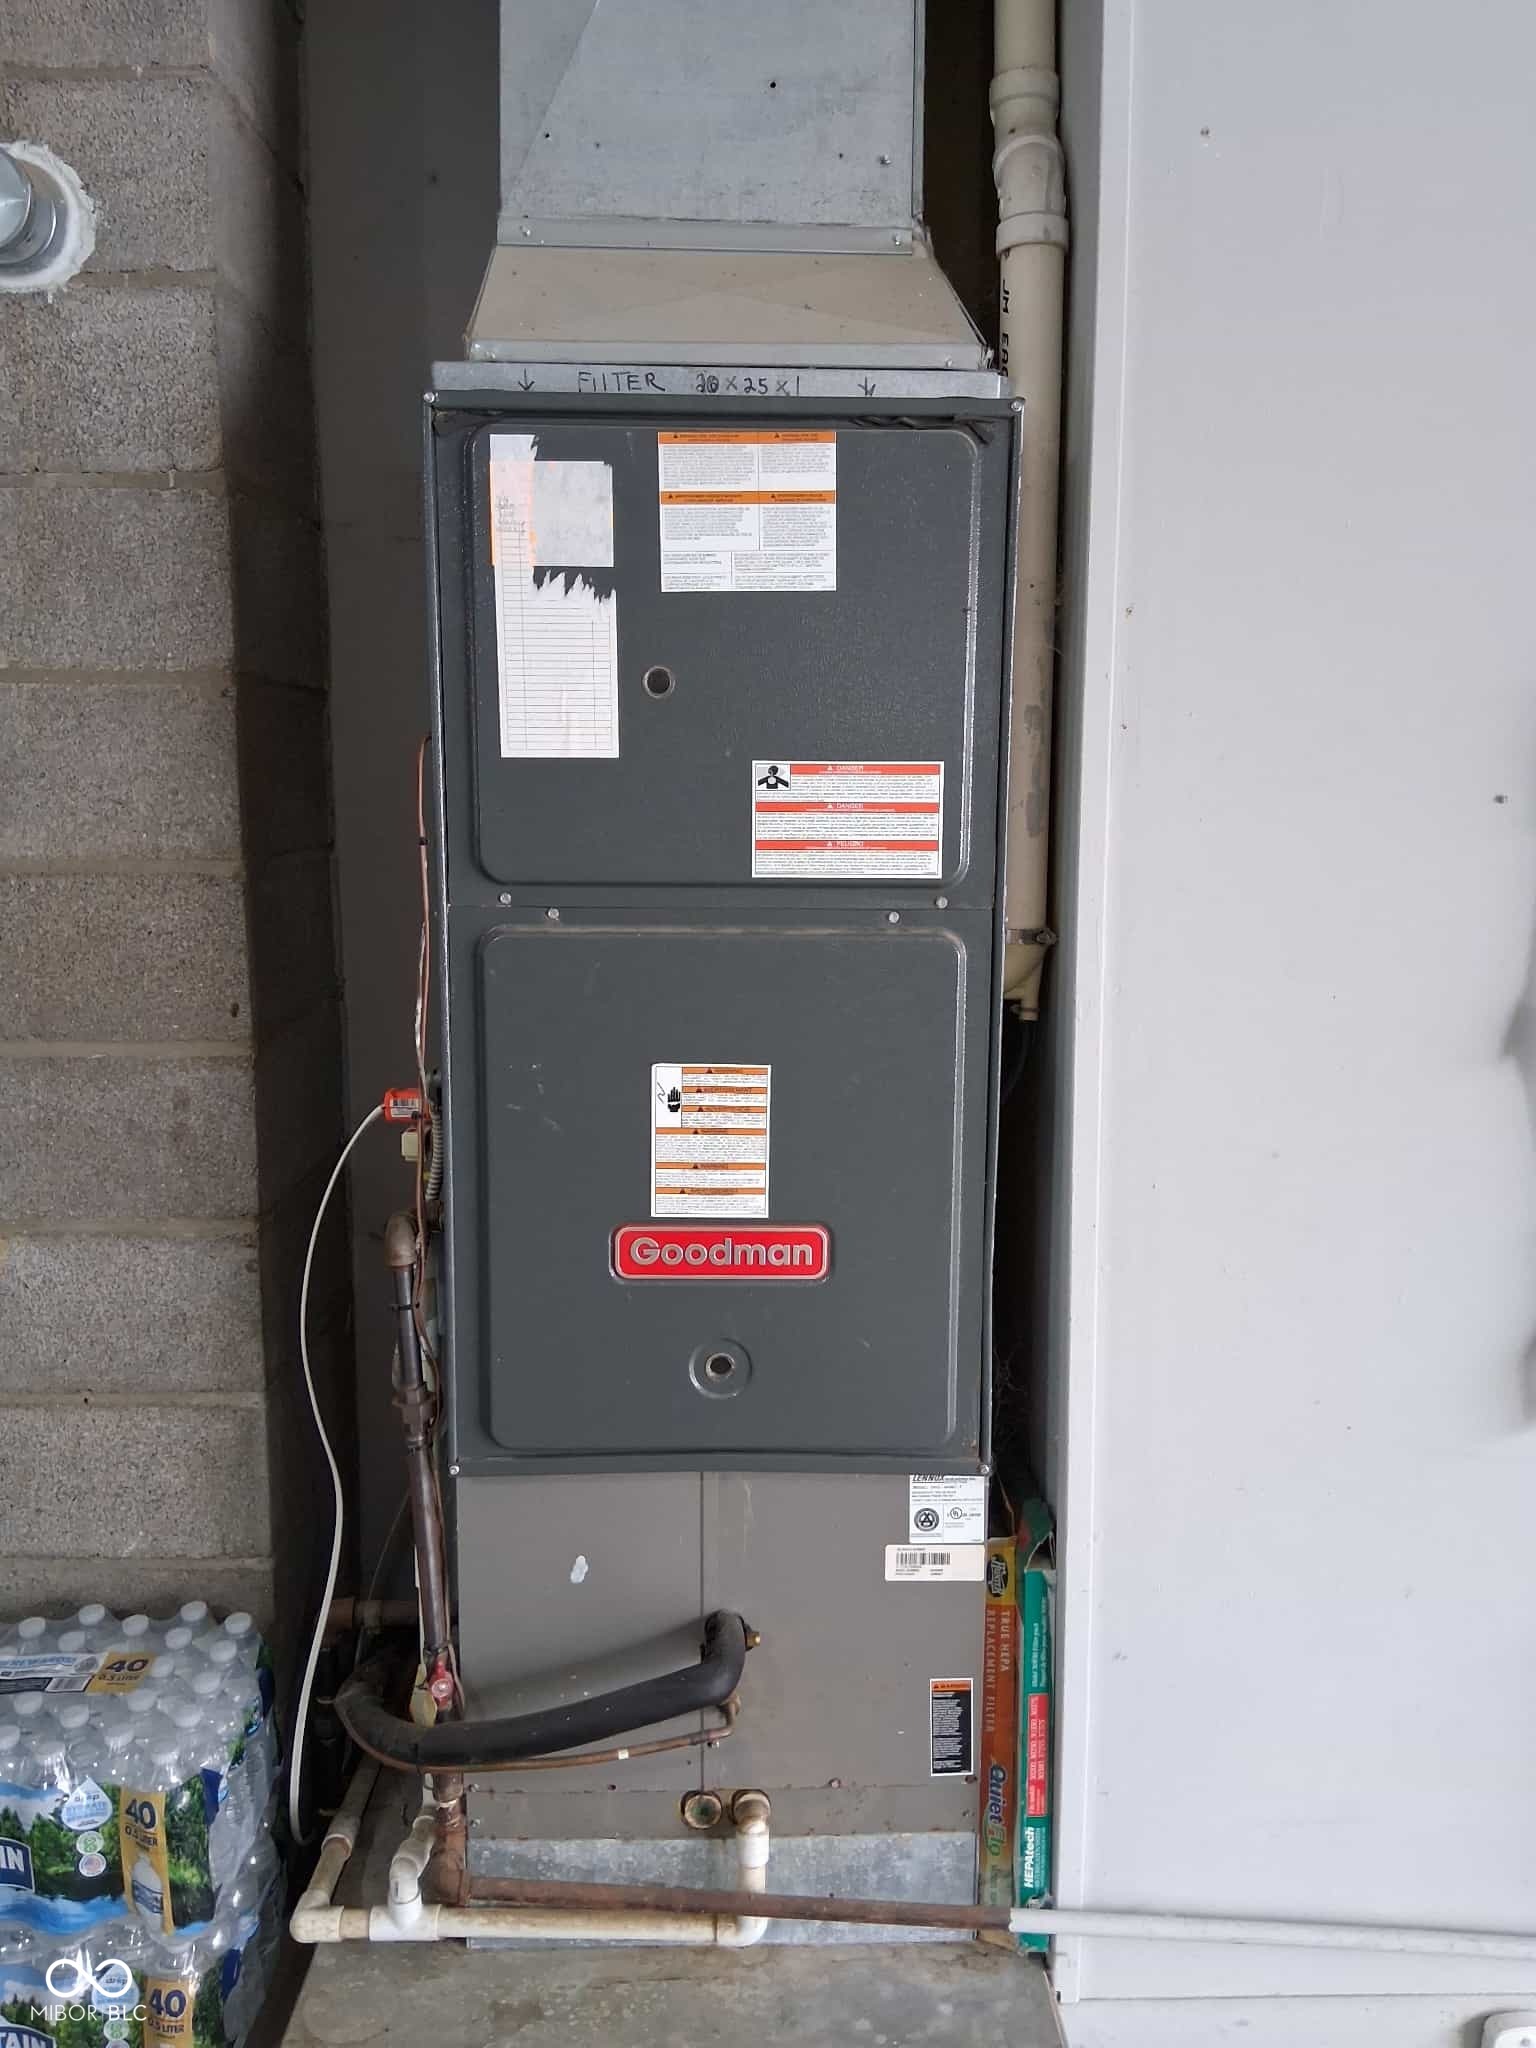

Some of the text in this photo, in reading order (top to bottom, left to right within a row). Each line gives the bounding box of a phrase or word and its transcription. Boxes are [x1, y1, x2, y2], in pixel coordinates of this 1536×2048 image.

[630, 1237, 813, 1266] Goodman
[1001, 1611, 1010, 1672] TRUE HEPA
[105, 1659, 149, 1672] 40
[126, 1798, 157, 1829] 40
[1023, 1826, 1035, 1889] HEPAtech
[151, 1988, 187, 2017] 40
